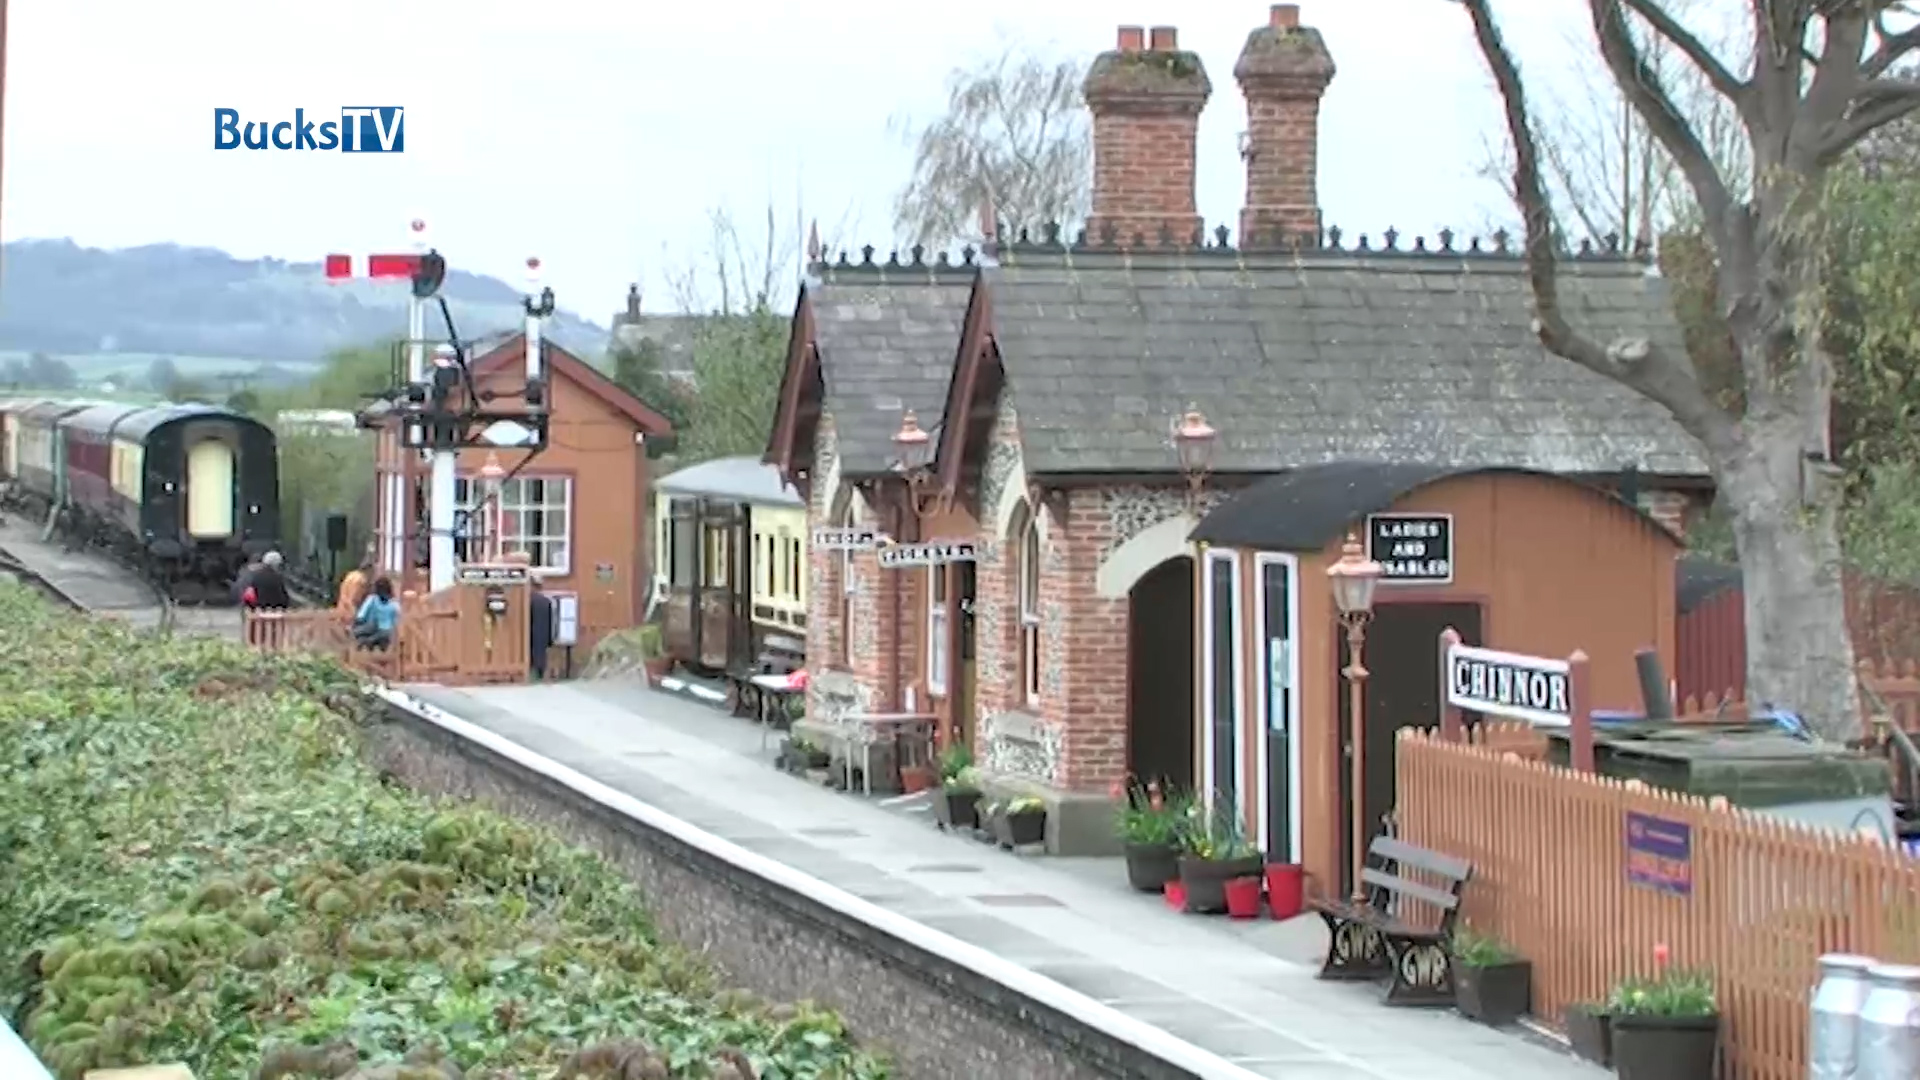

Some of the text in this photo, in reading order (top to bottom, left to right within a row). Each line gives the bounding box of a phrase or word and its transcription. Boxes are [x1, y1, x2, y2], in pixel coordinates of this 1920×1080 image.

[1379, 522, 1440, 537] LADIES
[1392, 541, 1426, 556] AND
[1456, 660, 1568, 712] CHINNOR
